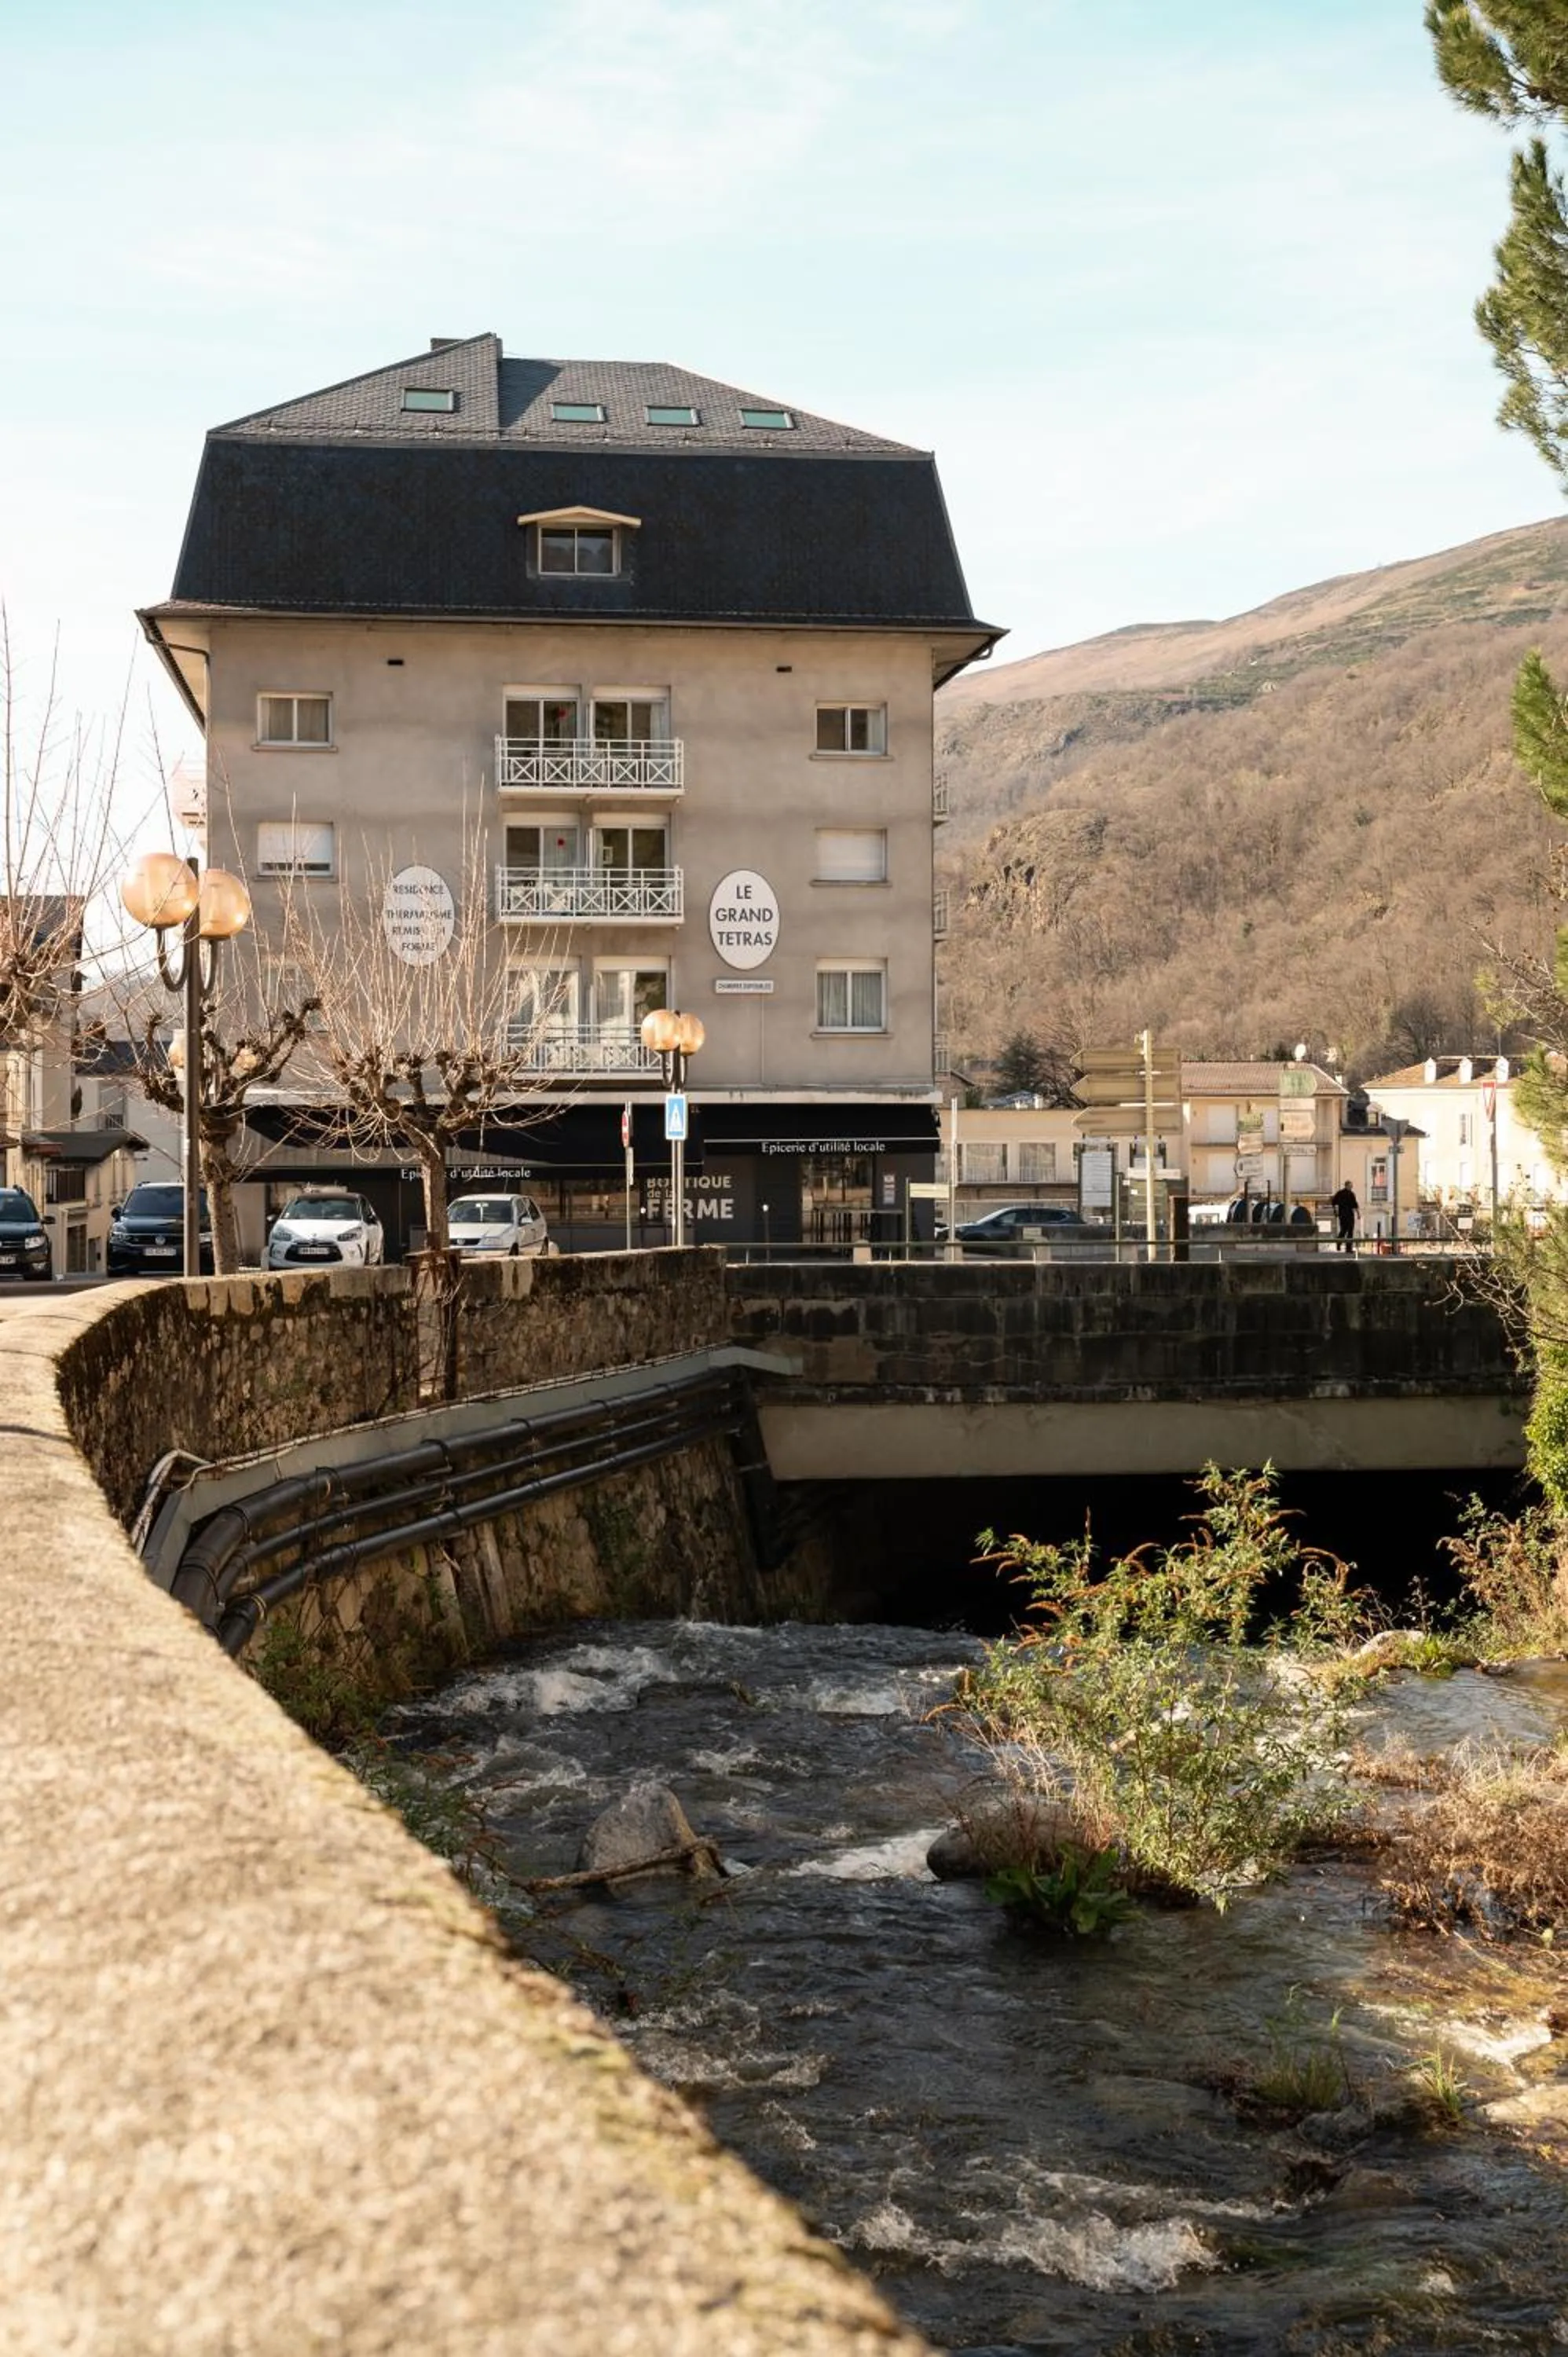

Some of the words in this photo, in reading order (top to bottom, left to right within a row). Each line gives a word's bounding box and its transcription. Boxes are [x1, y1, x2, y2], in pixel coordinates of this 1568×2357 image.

[736, 885, 752, 900] LE
[716, 907, 773, 922] GRAND
[717, 931, 772, 946] TETRAS
[761, 1141, 806, 1155] Epicerie
[808, 1140, 851, 1153] d'utilité
[854, 1139, 885, 1152] locale
[498, 1166, 532, 1178] locale
[647, 1176, 732, 1189] BOTIQUE
[647, 1189, 661, 1198] de
[647, 1198, 735, 1219] FERME
